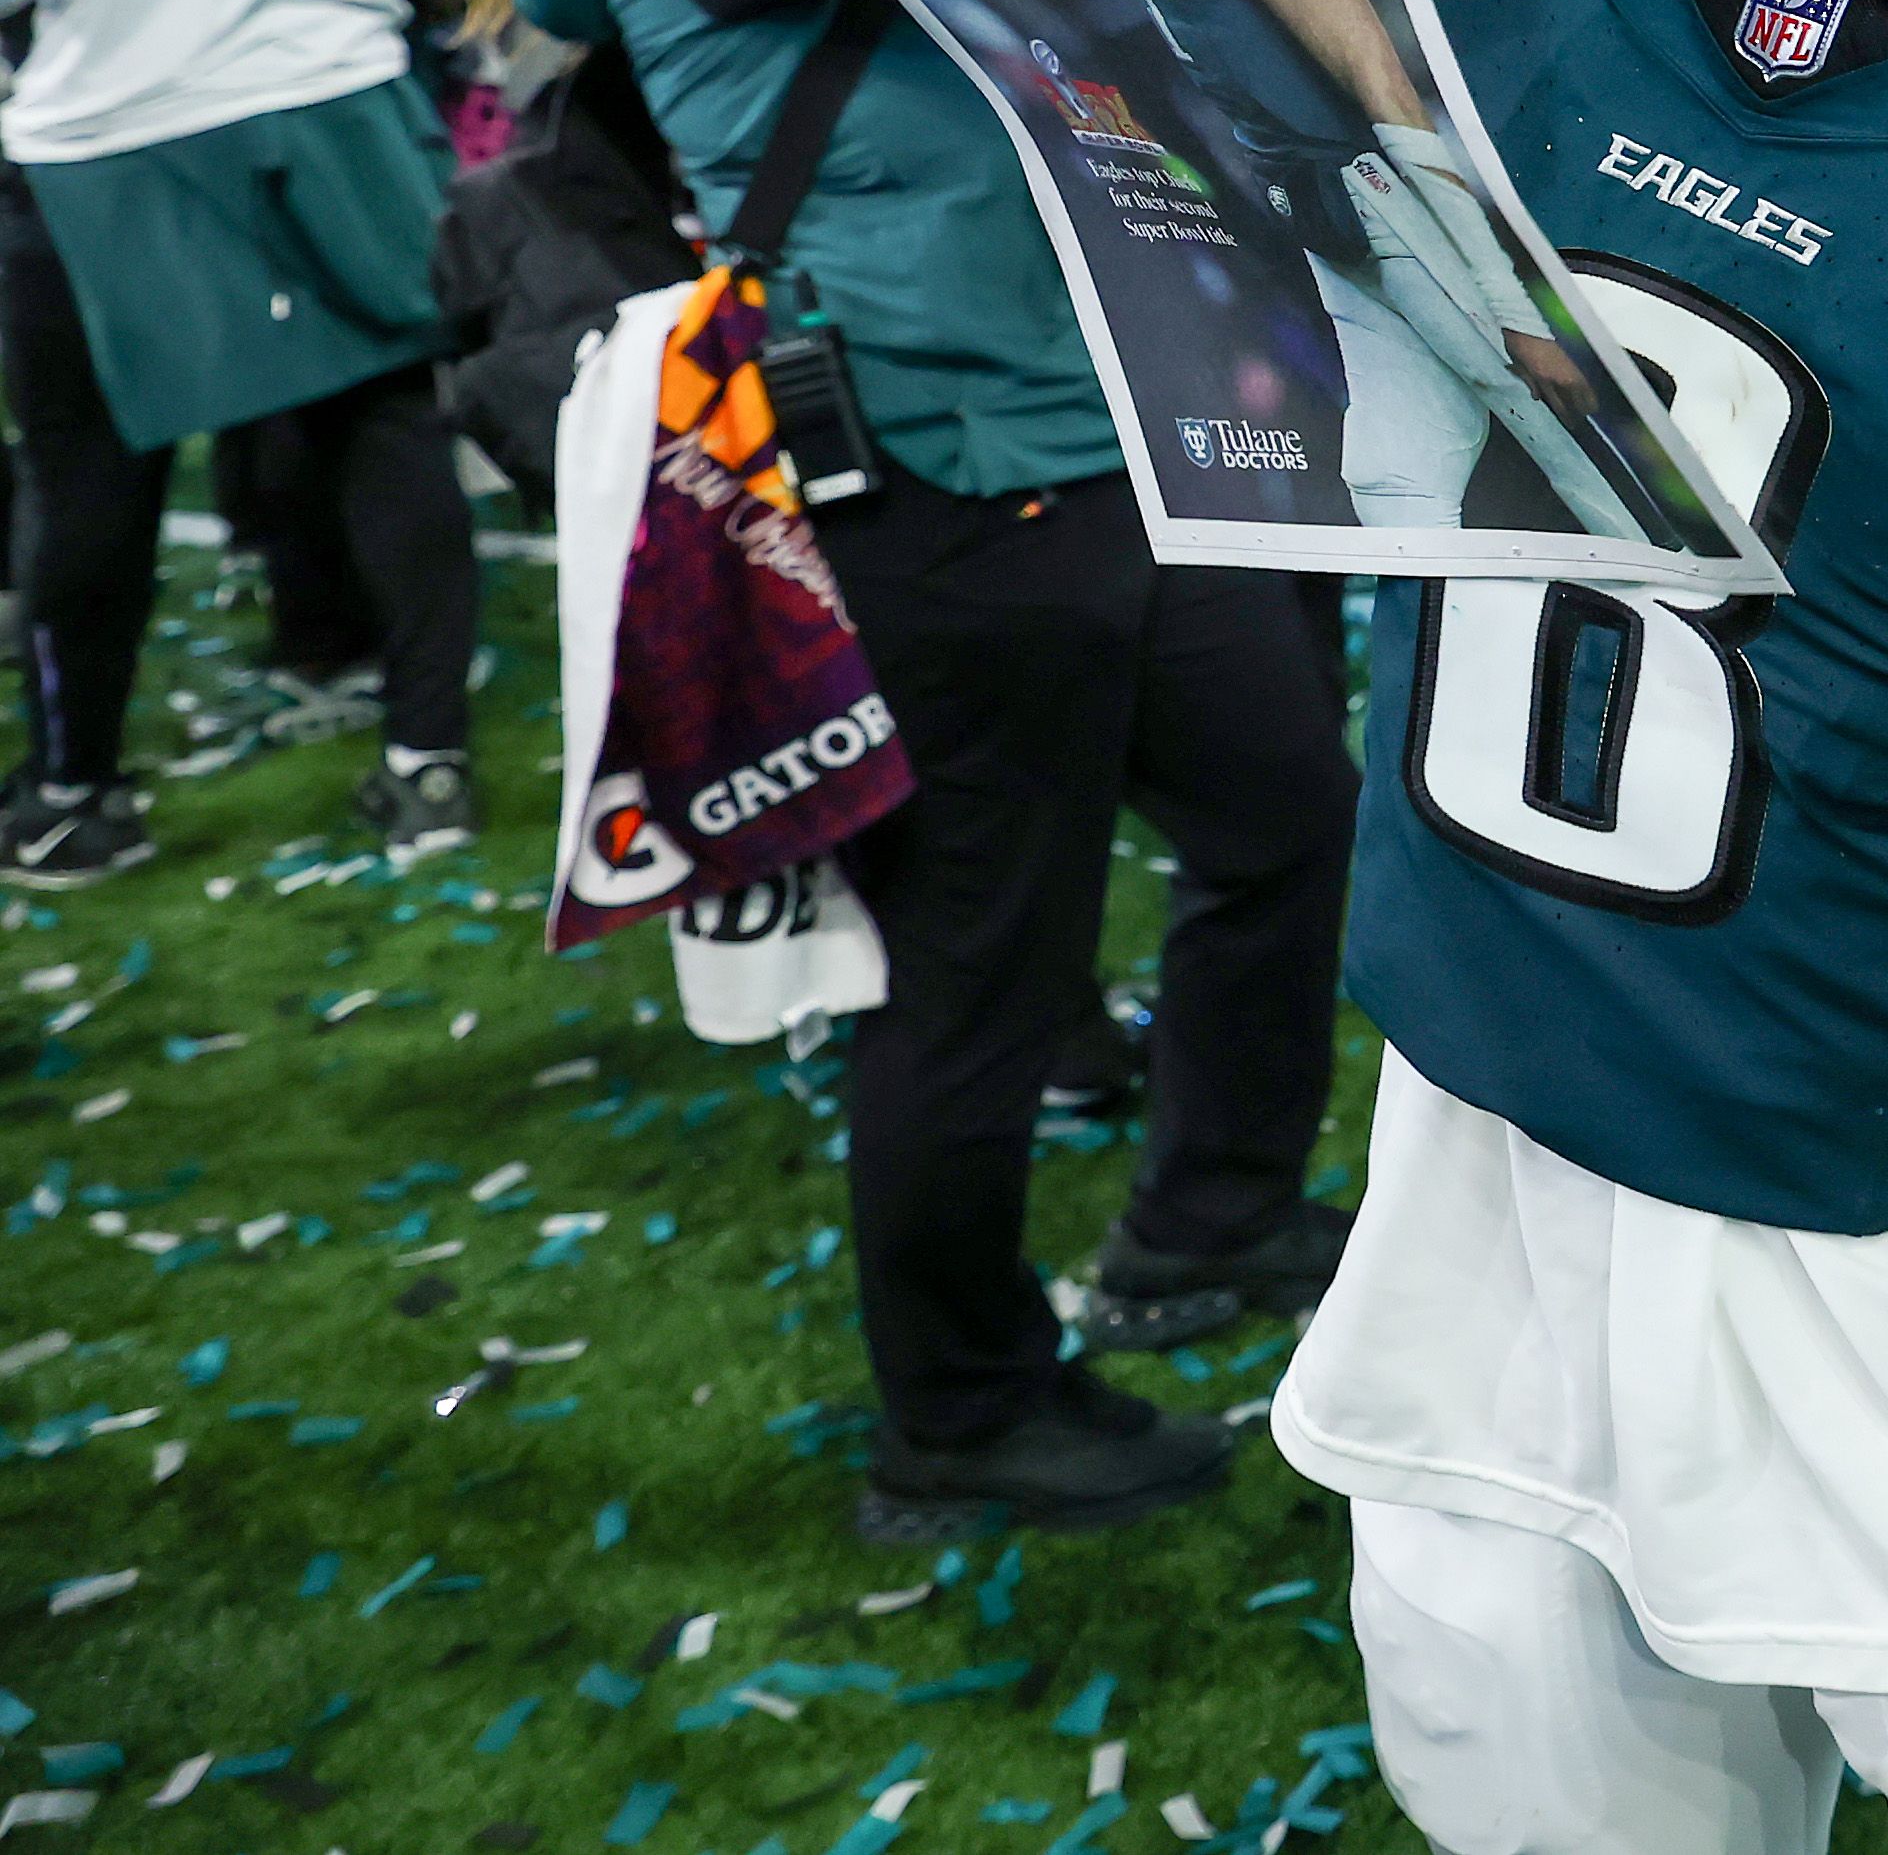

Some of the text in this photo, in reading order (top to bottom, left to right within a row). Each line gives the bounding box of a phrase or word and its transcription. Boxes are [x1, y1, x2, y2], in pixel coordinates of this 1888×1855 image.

[1747, 7, 1813, 62] NFL
[1596, 133, 1834, 267] EAGLES
[1122, 217, 1170, 243] Super
[1208, 419, 1304, 453] Tulane
[1221, 451, 1309, 470] DOCTORS
[1403, 248, 1831, 924] 8
